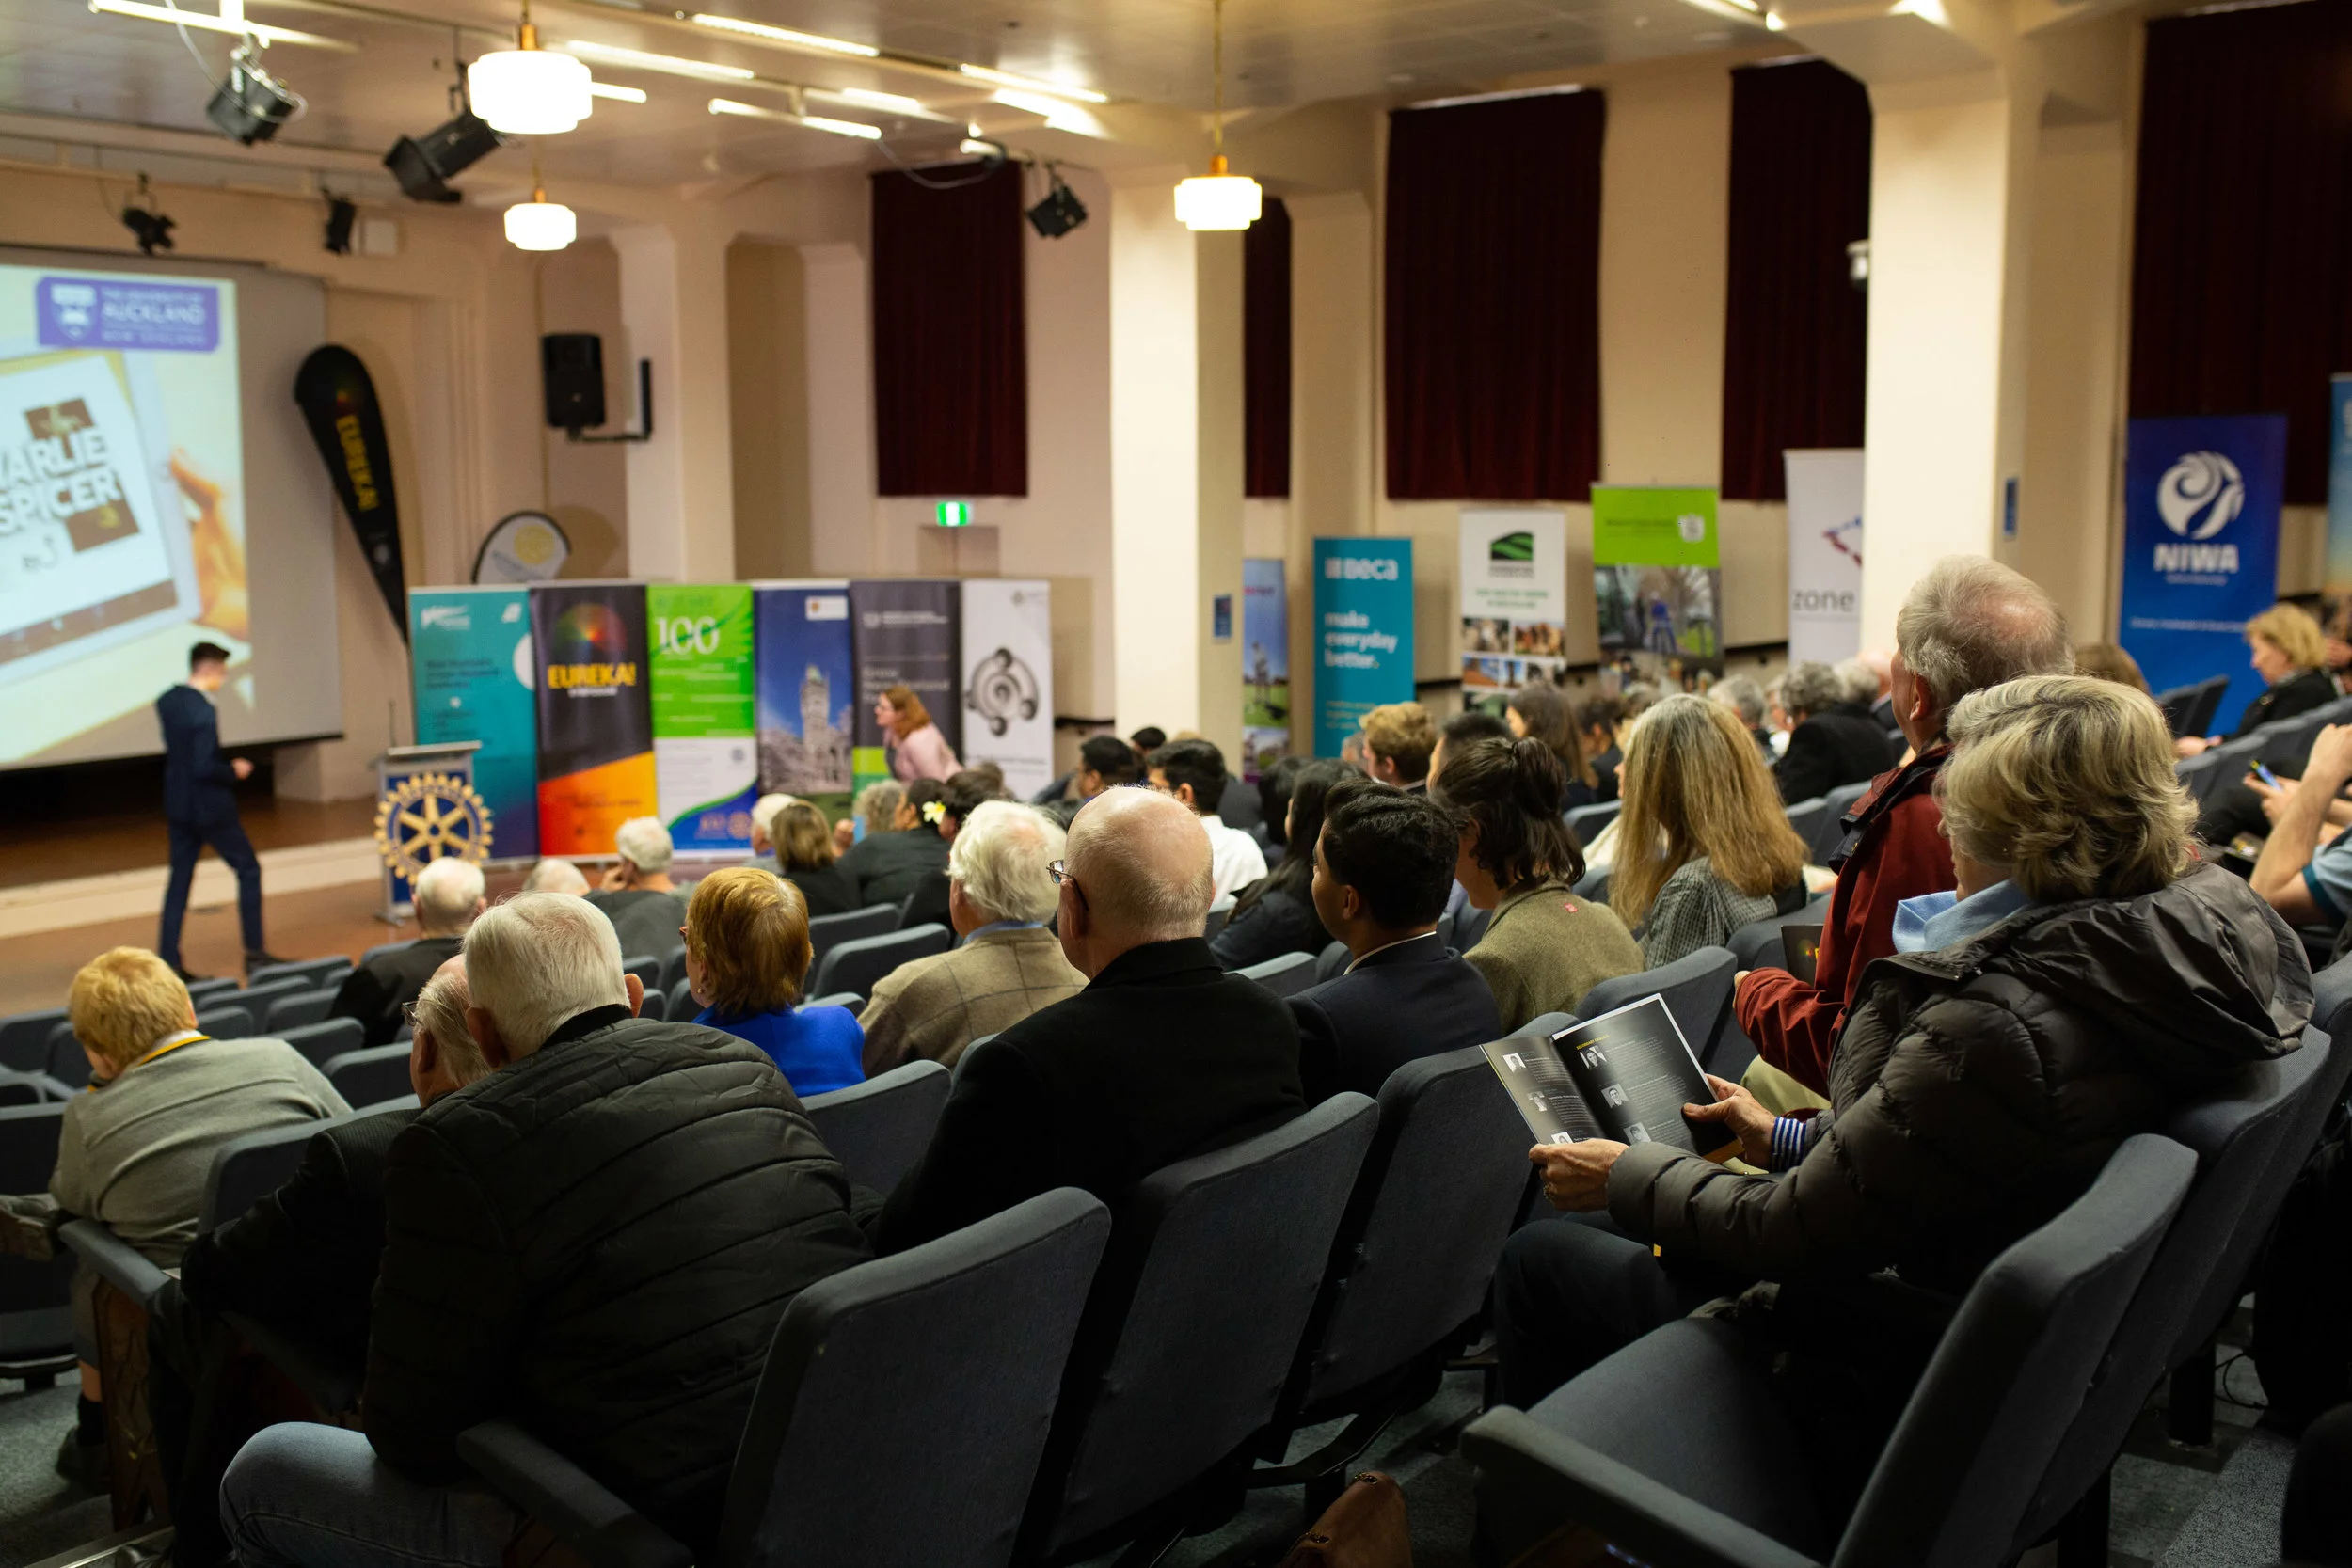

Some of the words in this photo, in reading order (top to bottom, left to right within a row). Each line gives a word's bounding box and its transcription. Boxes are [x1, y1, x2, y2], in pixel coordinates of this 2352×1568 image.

[102, 299, 206, 325] AUCKLAND
[0, 432, 108, 498] ARLIE
[2152, 544, 2240, 574] NIWA
[1791, 589, 1855, 613] zone
[1324, 611, 1370, 629] make
[654, 615, 720, 656] 100
[1324, 630, 1399, 653] everyday
[1324, 649, 1379, 669] better.
[548, 662, 637, 689] EUREKA!
